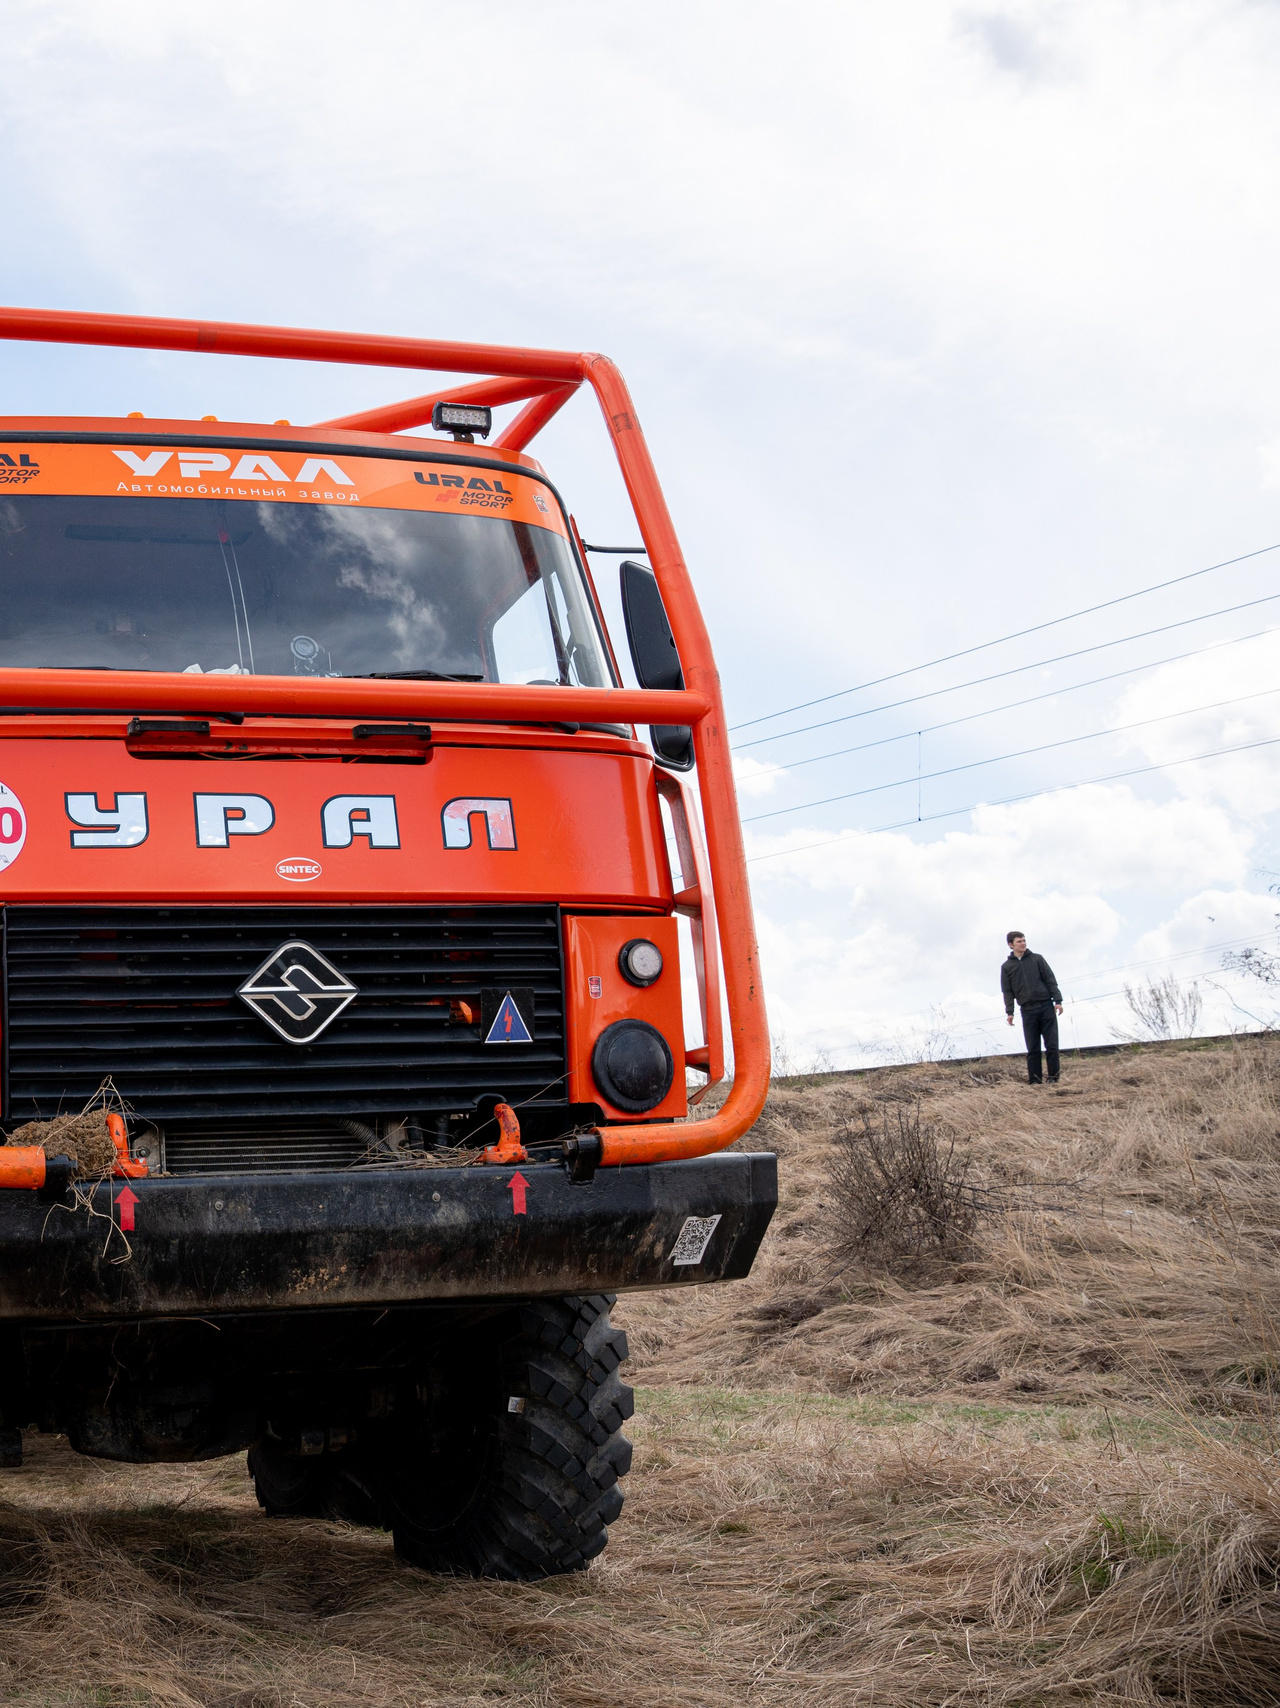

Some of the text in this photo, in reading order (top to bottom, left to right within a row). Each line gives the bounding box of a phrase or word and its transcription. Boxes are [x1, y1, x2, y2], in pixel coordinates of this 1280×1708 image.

[111, 450, 356, 486] УРАЛ
[116, 481, 360, 502] Автомобильный завод
[413, 471, 512, 495] URAL
[459, 497, 509, 510] SPORT
[462, 491, 514, 504] MOTOR
[64, 792, 518, 852] УРАЛ
[278, 865, 319, 874] SINTEC
